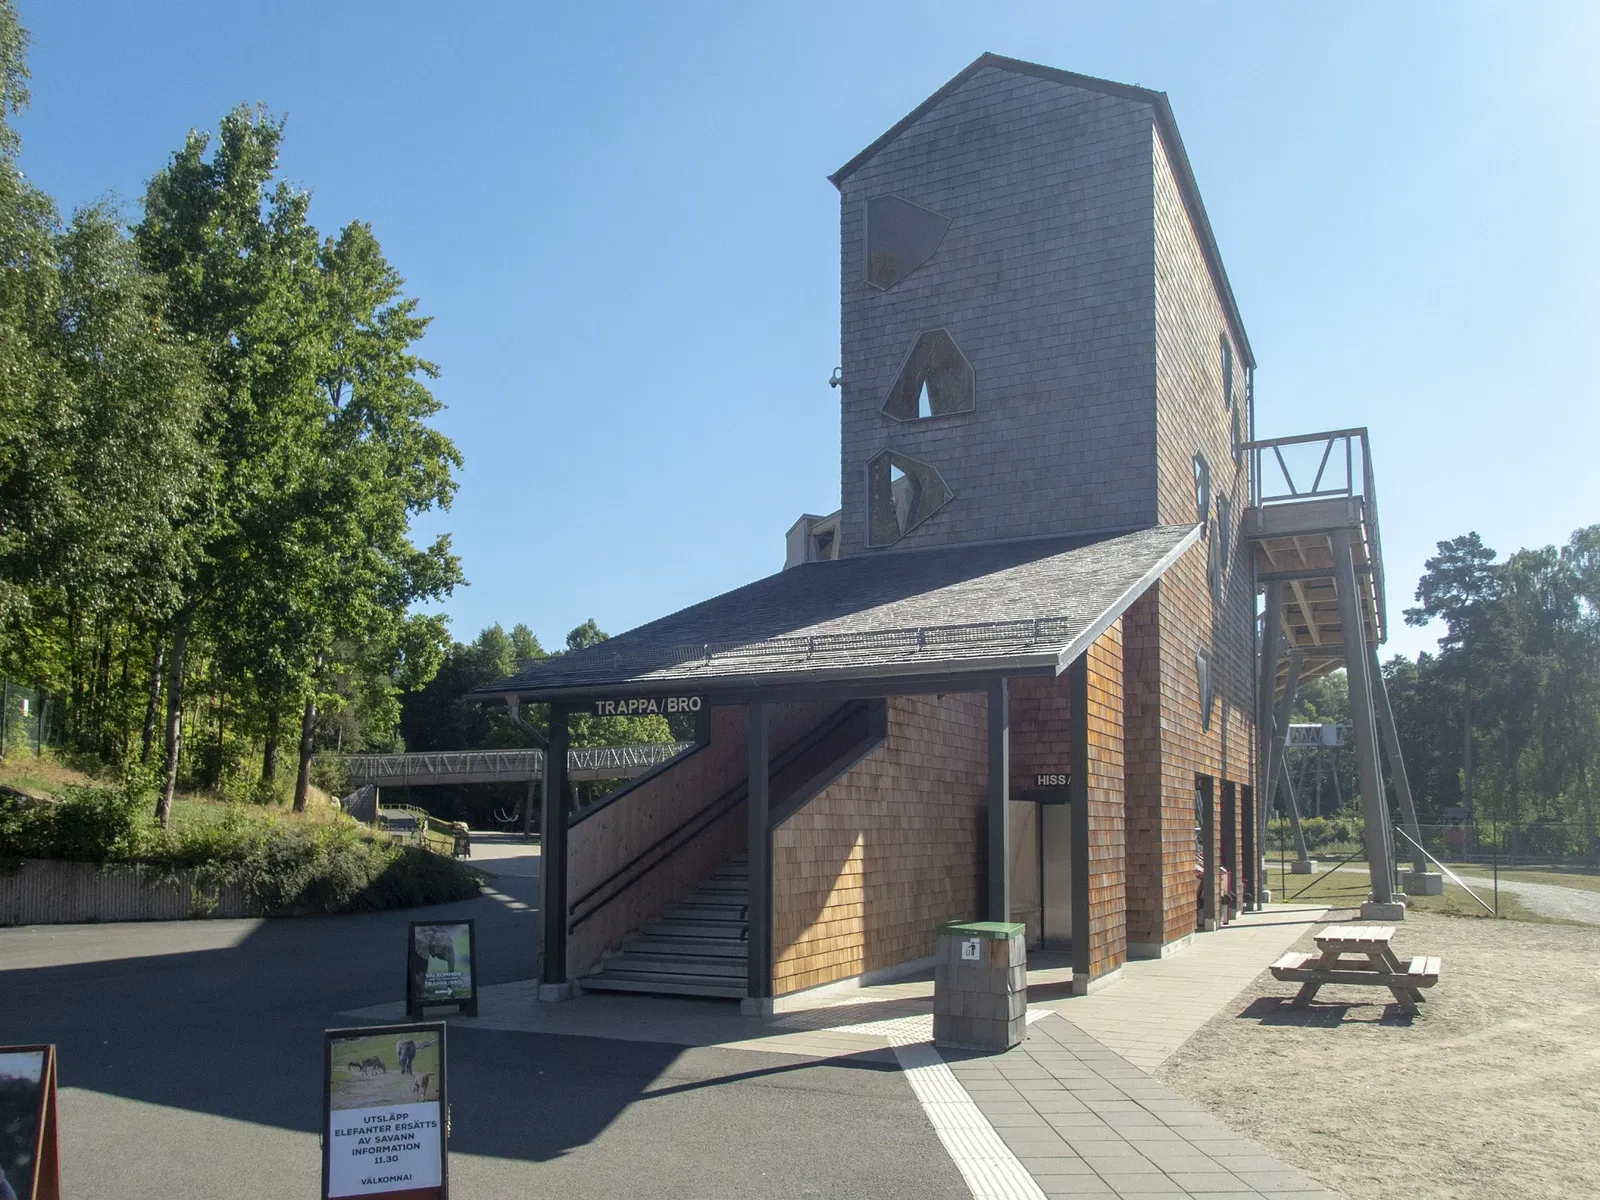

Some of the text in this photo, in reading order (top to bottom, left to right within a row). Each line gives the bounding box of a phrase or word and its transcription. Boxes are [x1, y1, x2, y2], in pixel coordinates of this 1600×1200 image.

[364, 1112, 409, 1124] UTSLÄPP
[334, 1120, 437, 1137] ELEFANTER ERSÄTTS
[358, 1133, 415, 1145] AV SAVANN
[352, 1142, 420, 1156] INFORMATION
[374, 1155, 399, 1164] 11.30
[361, 1174, 412, 1185] VÄLKOMNA!
